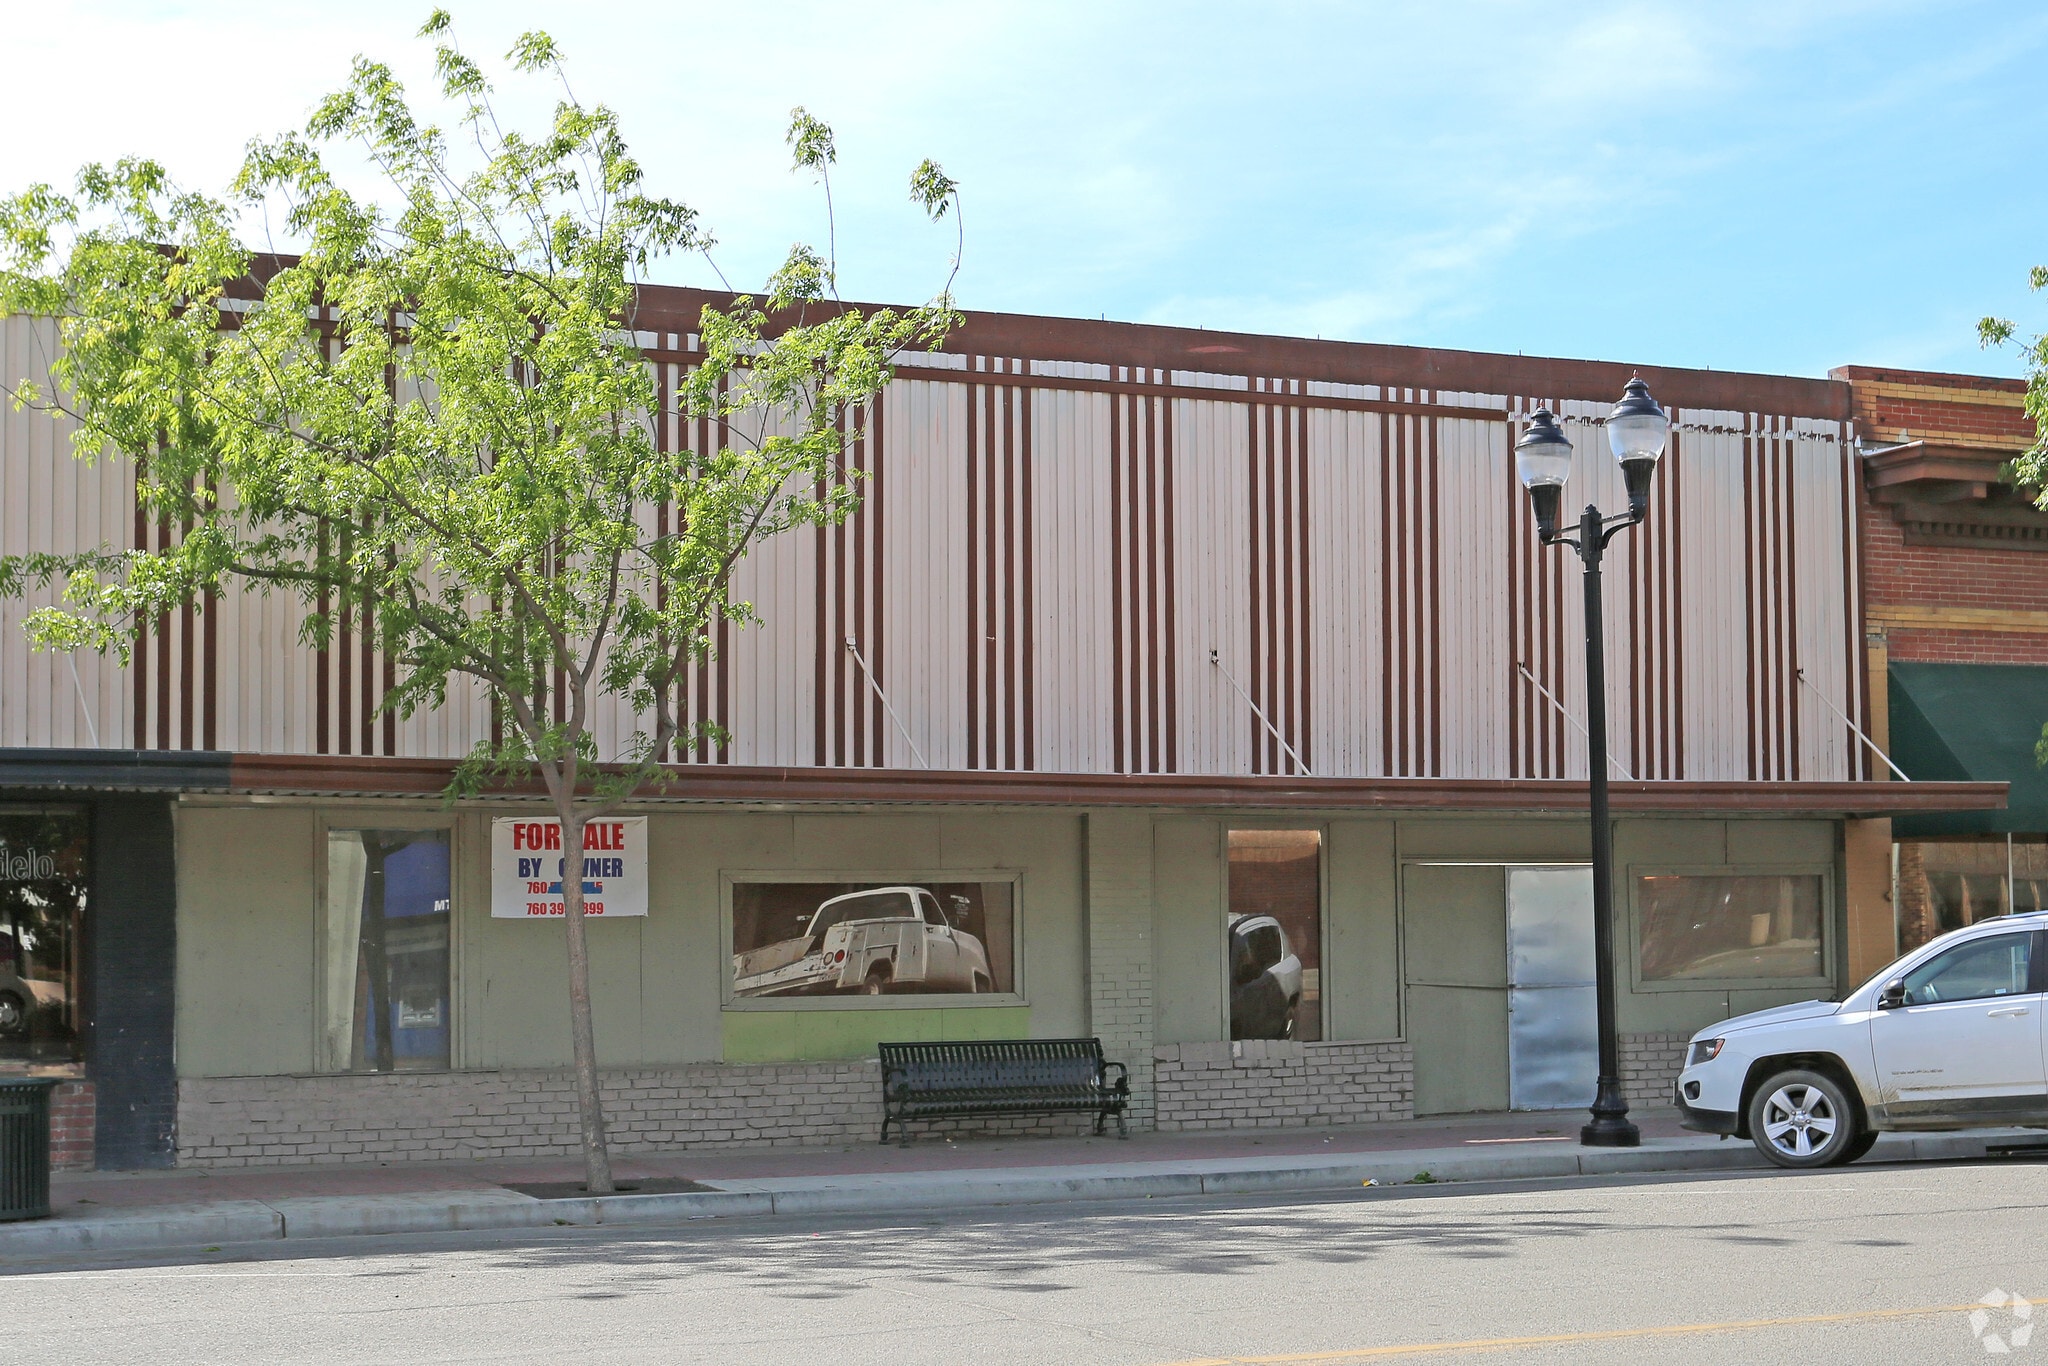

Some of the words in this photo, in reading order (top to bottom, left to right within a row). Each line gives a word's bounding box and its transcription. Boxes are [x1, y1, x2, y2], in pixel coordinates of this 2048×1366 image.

[513, 823, 561, 850] FOR
[583, 823, 625, 850] ALE
[518, 857, 543, 878] BY
[526, 881, 548, 894] 760
[526, 902, 547, 915] 760
[549, 902, 566, 916] 39
[582, 902, 604, 915] 899
